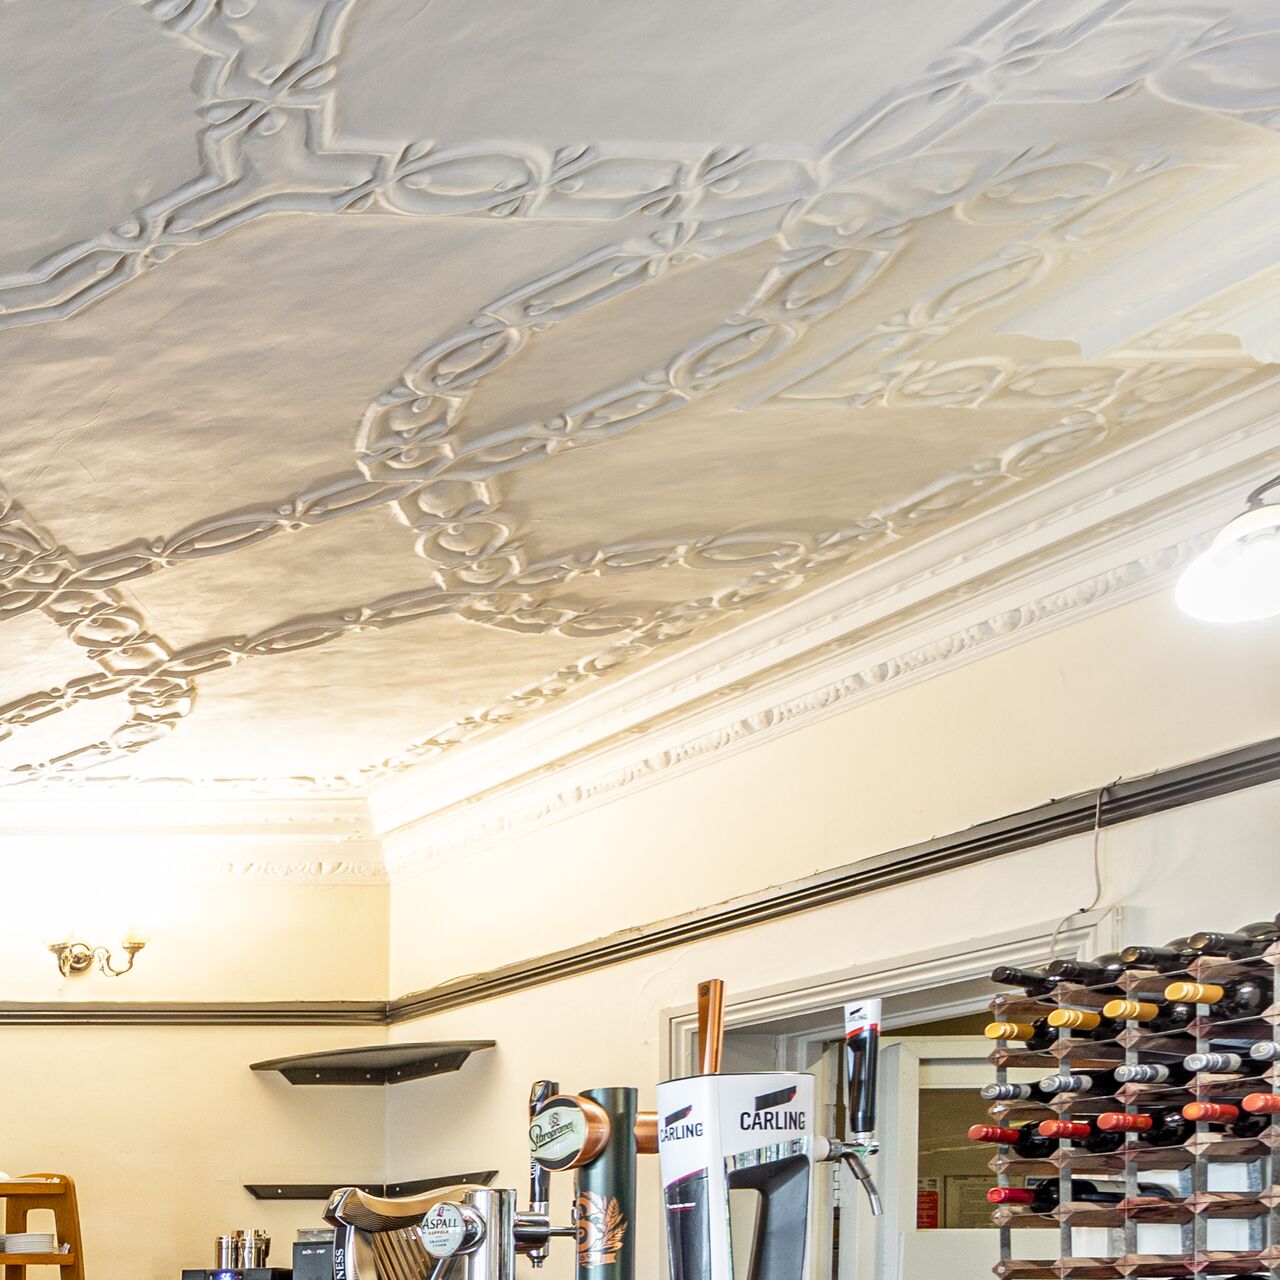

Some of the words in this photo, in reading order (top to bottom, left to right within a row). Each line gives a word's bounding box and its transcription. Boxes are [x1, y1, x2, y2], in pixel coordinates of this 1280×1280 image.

[739, 1111, 806, 1131] CARLING
[660, 1122, 704, 1142] CARLING
[421, 1217, 458, 1231] ASPALL
